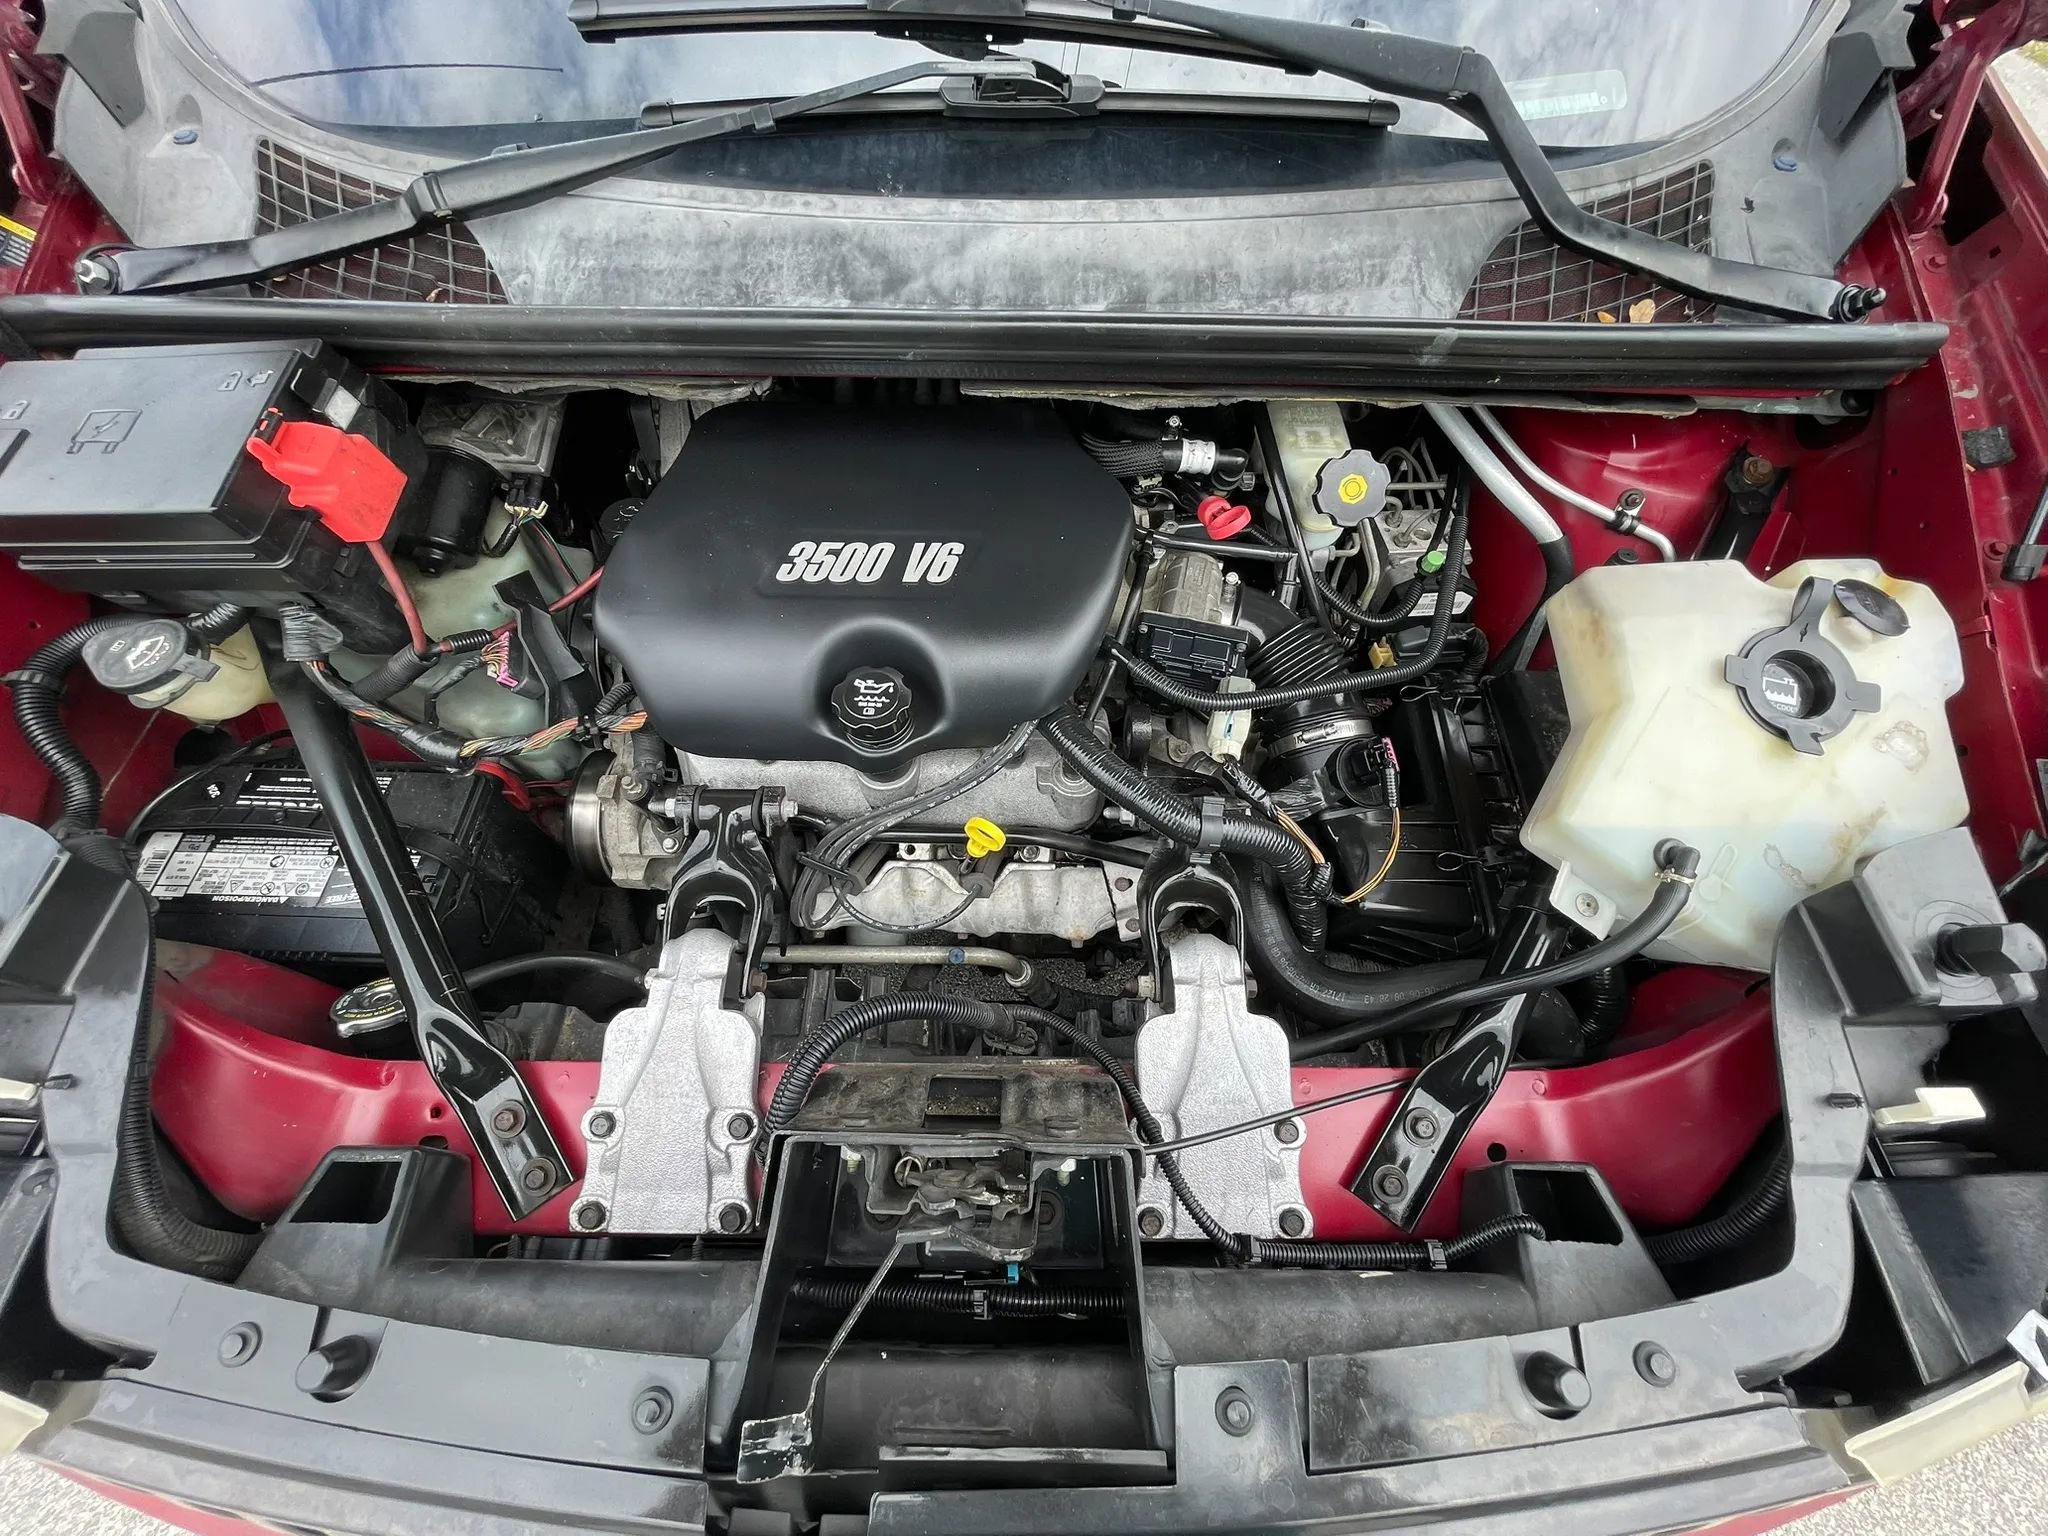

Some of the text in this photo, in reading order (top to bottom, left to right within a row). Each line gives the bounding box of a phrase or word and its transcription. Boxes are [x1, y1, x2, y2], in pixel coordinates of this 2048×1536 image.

[776, 541, 965, 584] 3500 V6
[212, 894, 279, 904] DANGER/POISON
